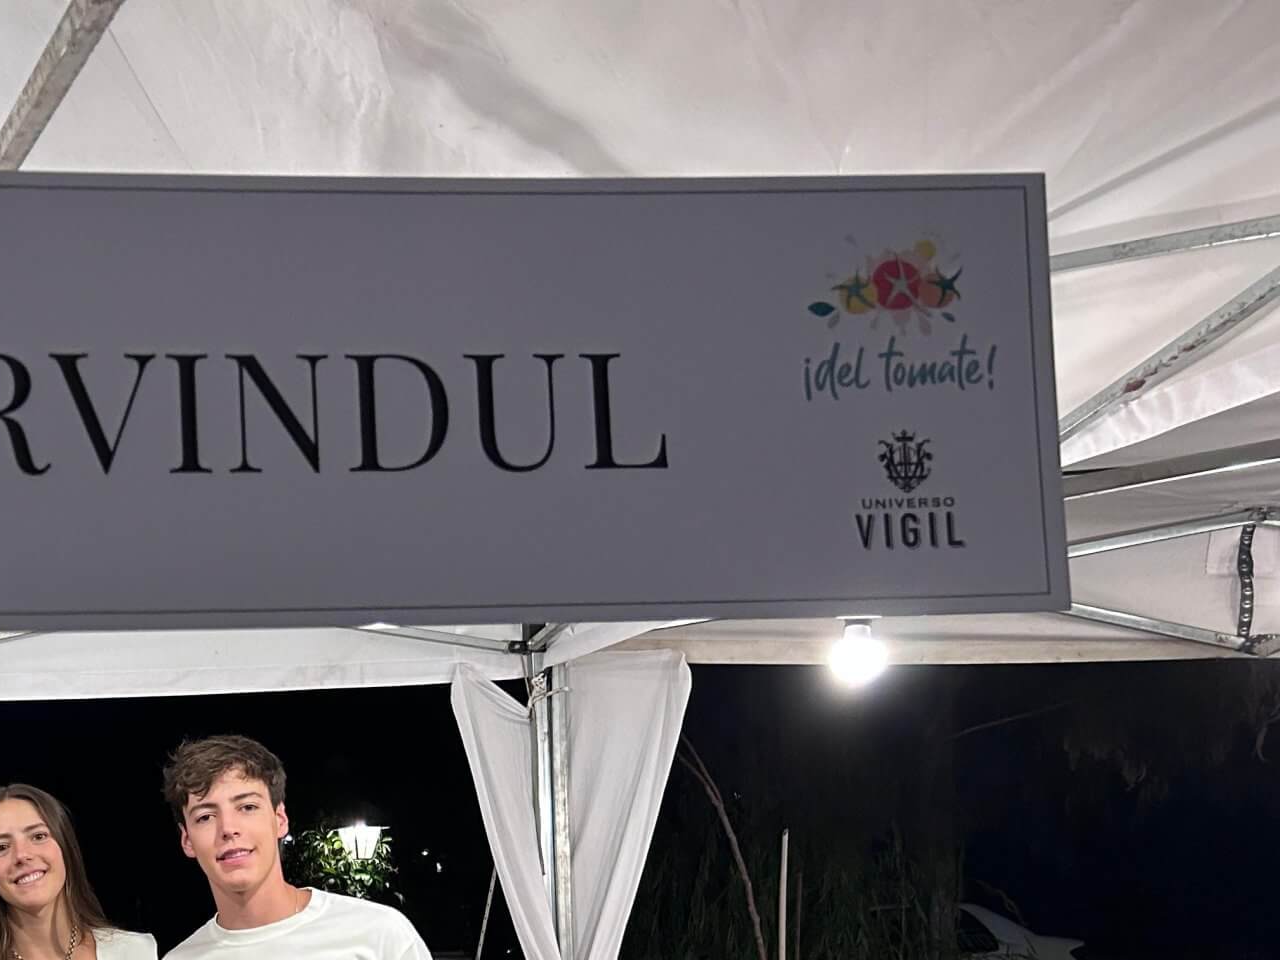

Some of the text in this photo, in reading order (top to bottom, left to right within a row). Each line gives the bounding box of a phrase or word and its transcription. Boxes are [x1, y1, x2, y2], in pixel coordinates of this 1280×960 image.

[878, 333, 998, 391] tomate!
[861, 496, 956, 510] UNIVERSO
[854, 511, 967, 550] VIGIL
